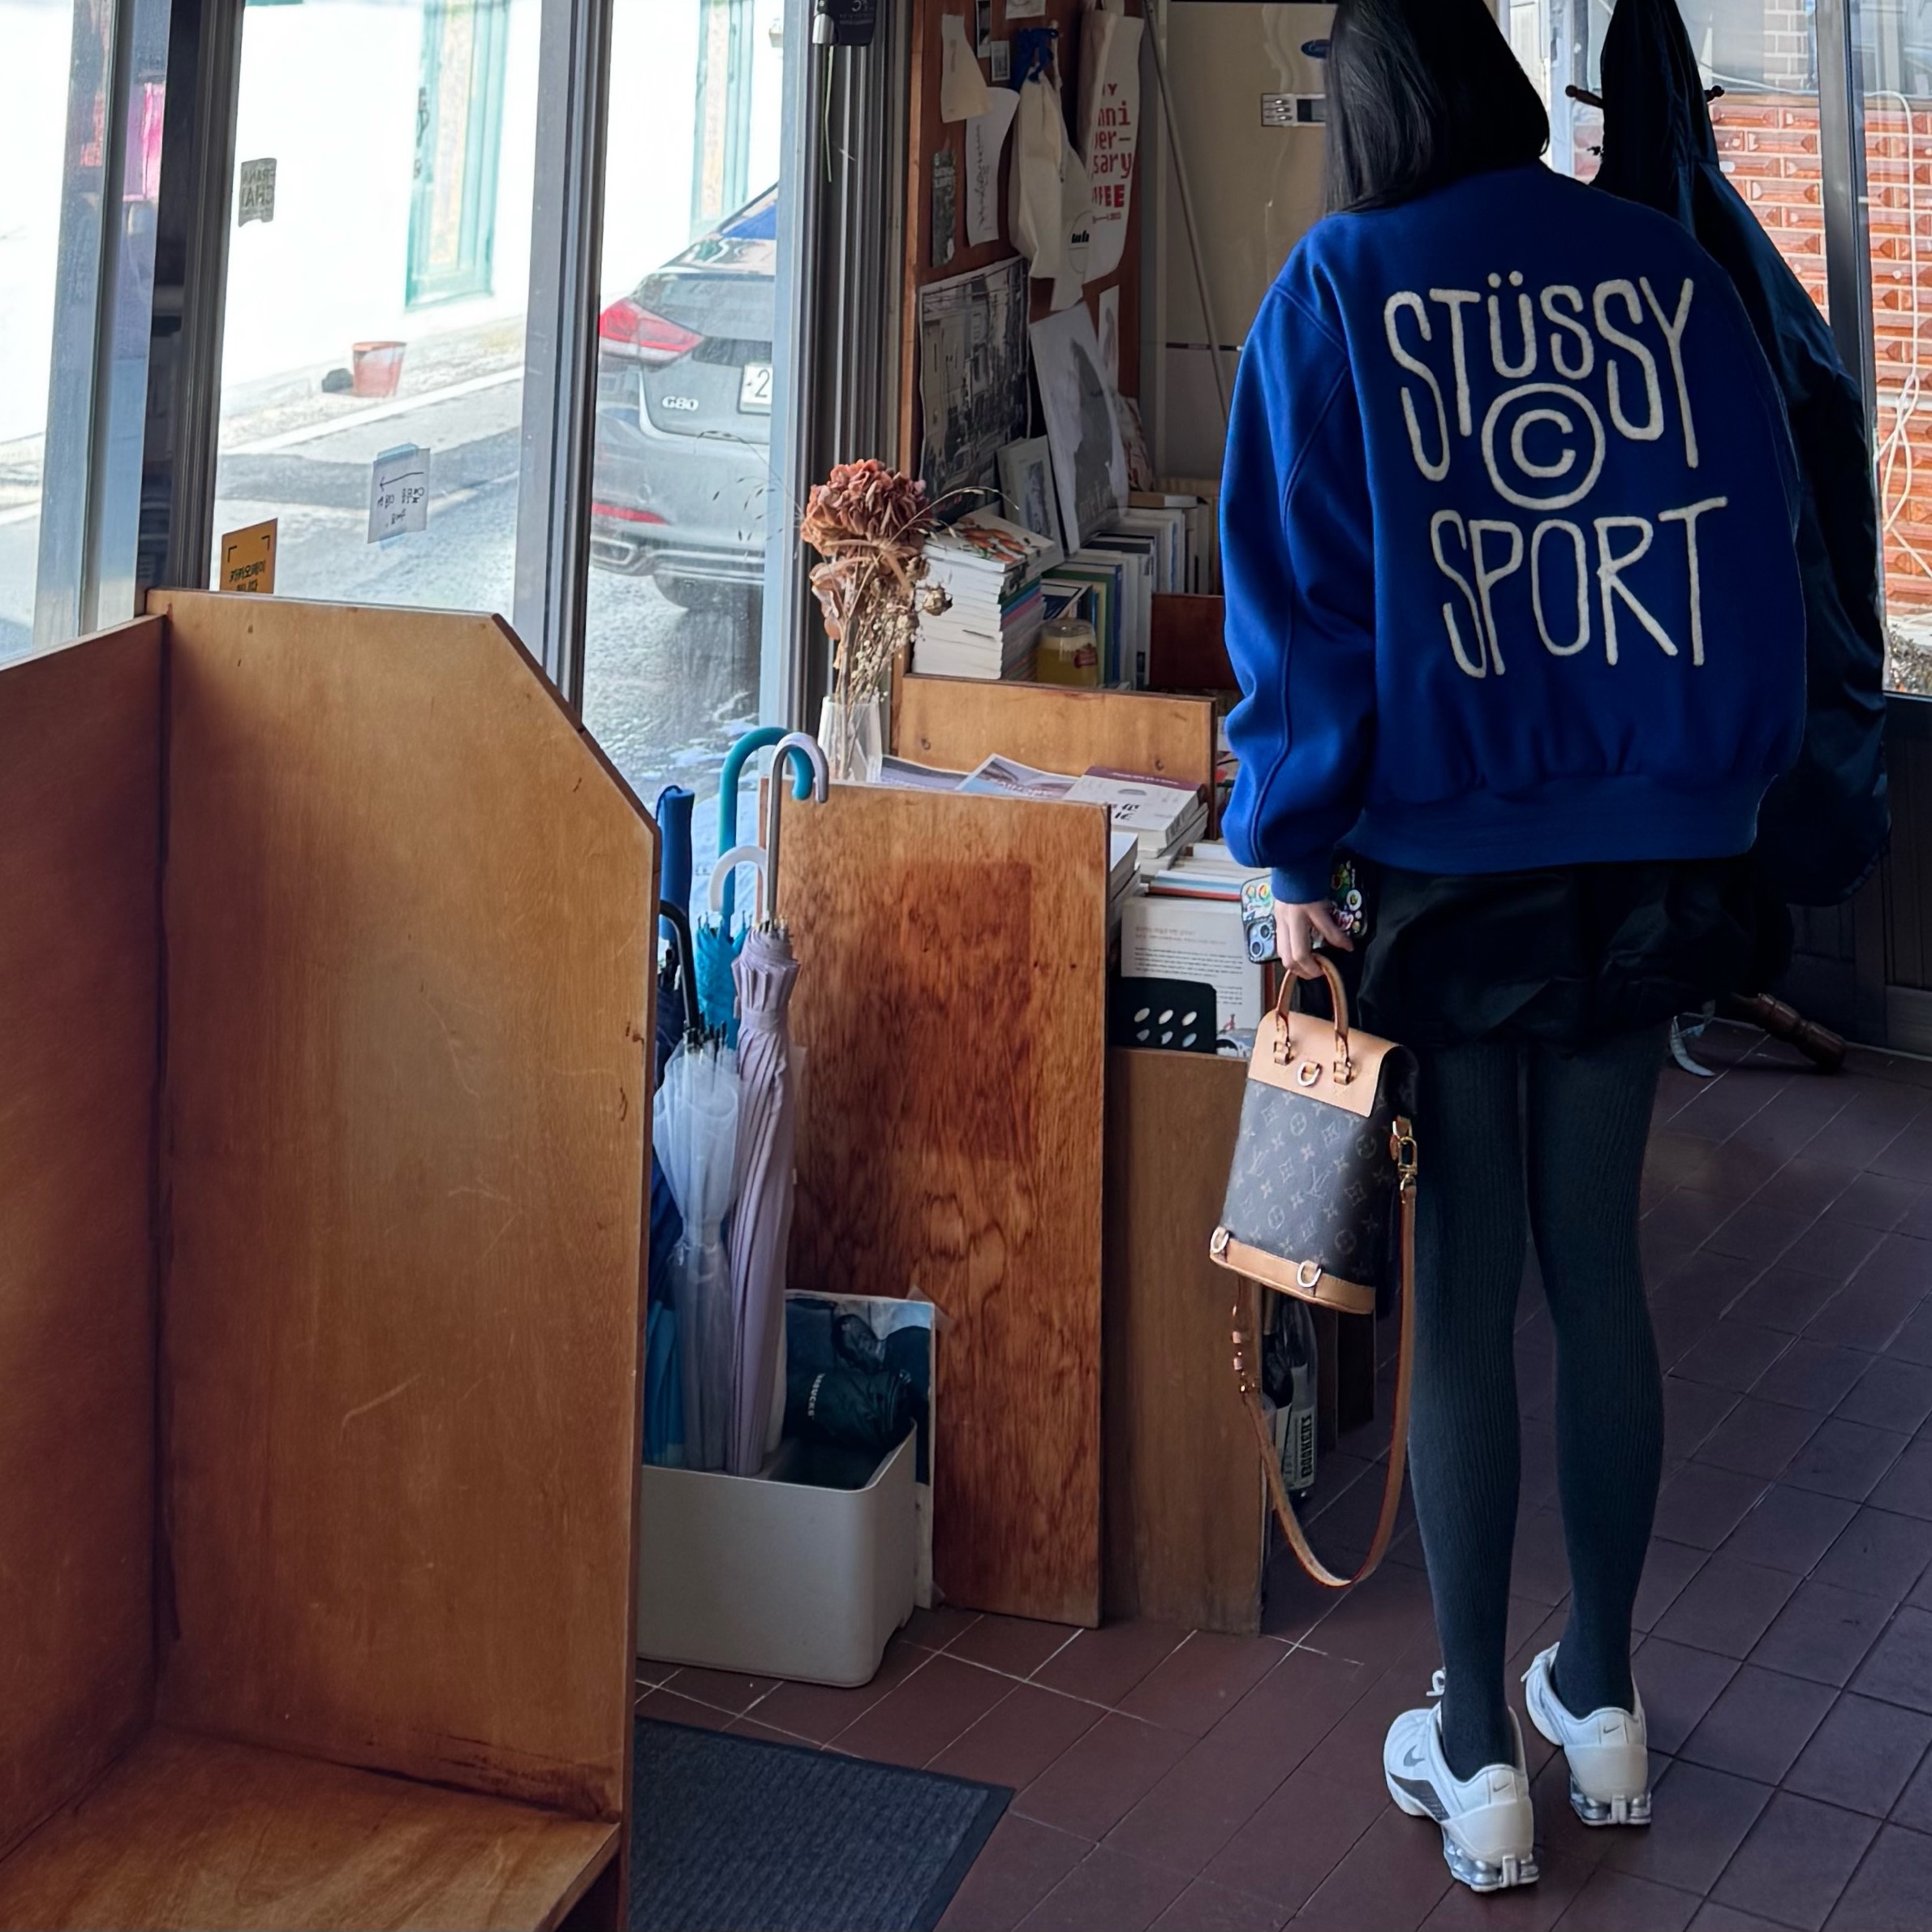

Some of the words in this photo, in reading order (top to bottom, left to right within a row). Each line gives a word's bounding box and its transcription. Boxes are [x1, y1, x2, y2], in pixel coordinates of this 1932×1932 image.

[661, 396, 699, 411] G80
[1384, 271, 1698, 481] STÜSSY
[1430, 496, 1727, 678] SPORT
